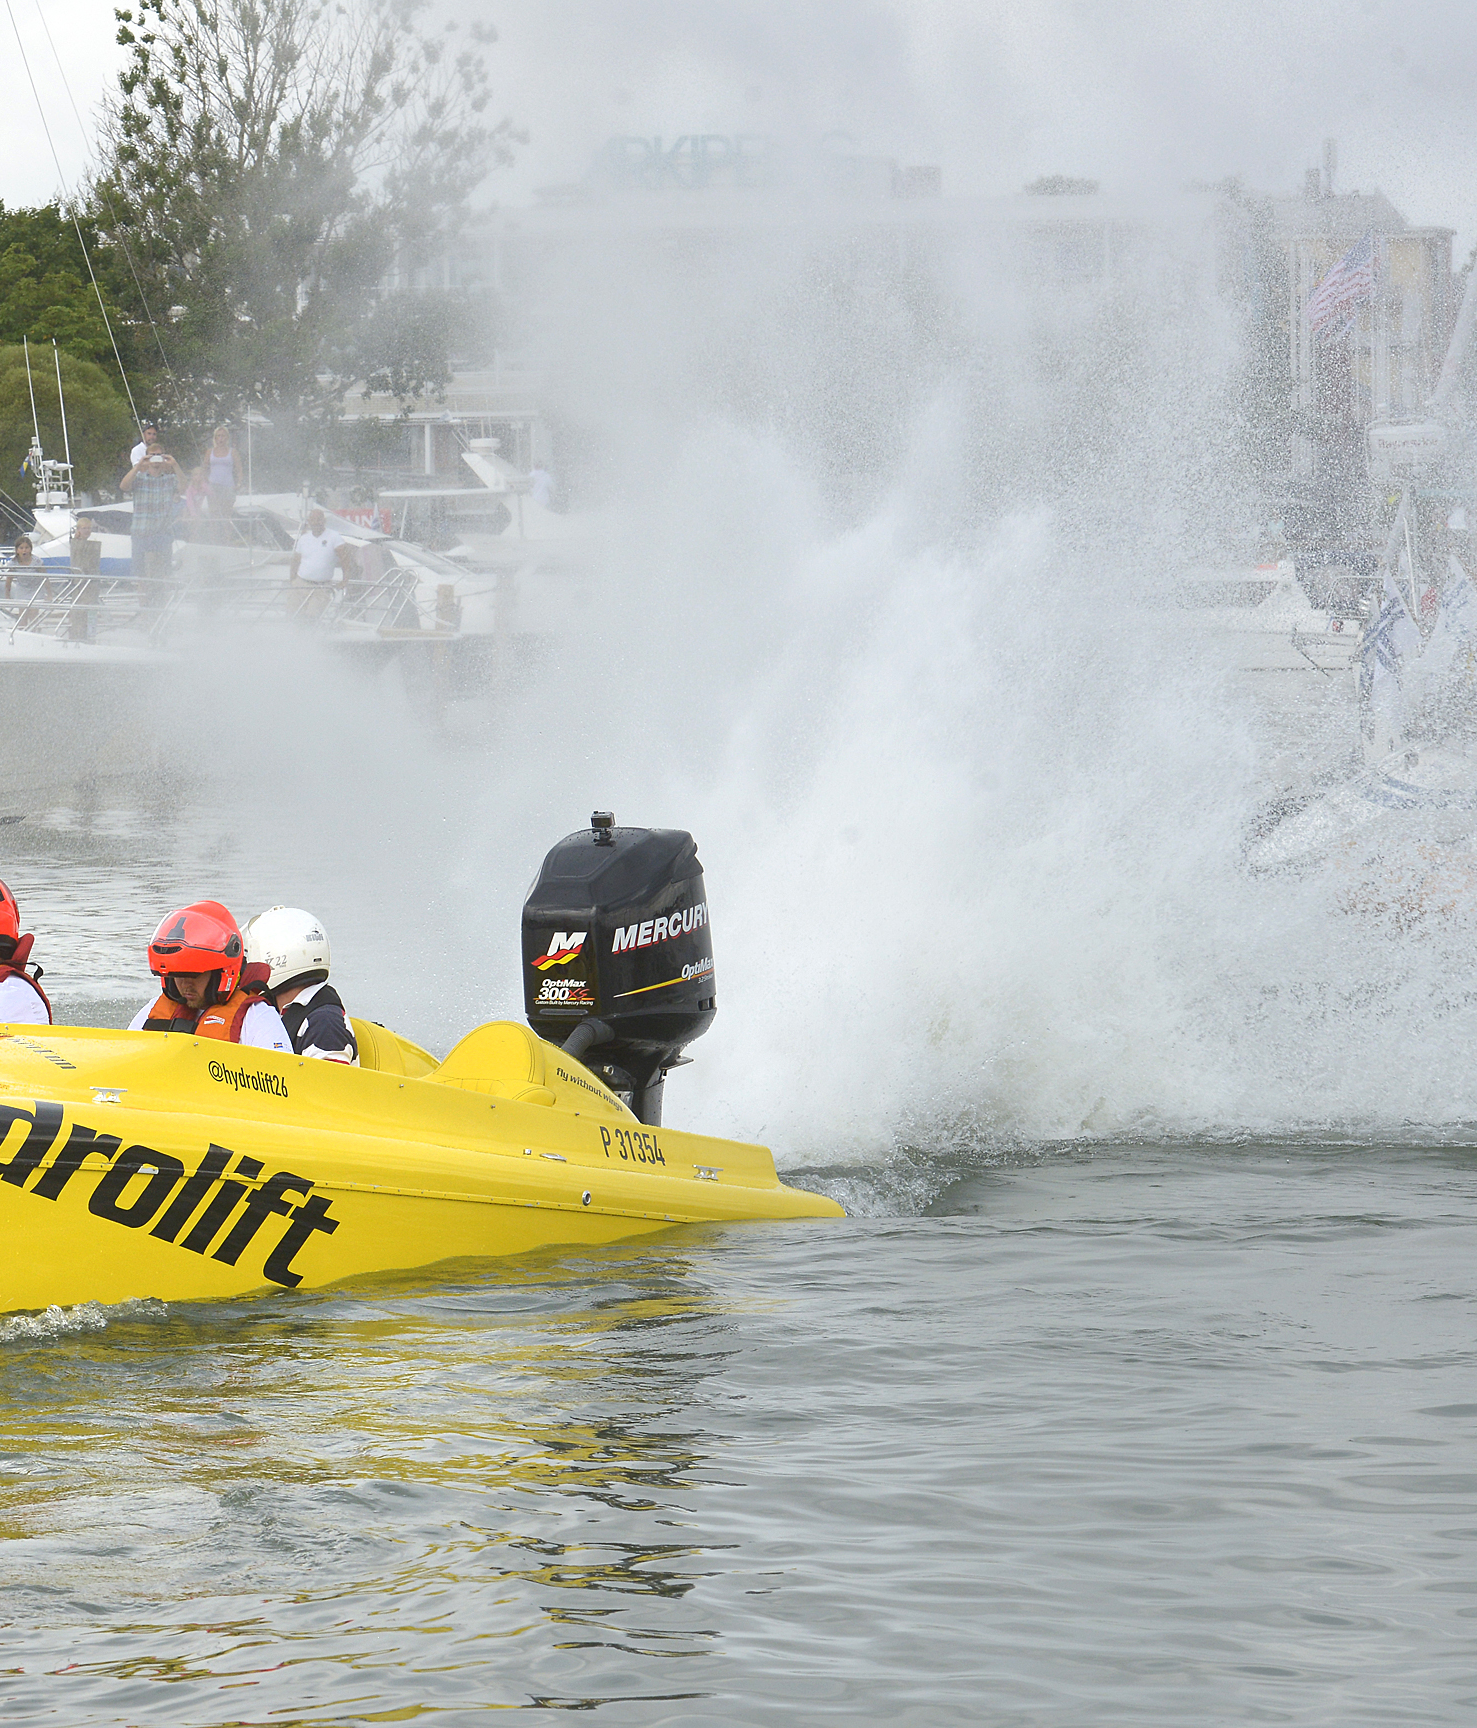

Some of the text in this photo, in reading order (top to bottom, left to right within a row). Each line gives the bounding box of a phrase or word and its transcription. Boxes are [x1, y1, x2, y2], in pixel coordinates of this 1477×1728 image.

[611, 902, 709, 955] MERCURY
[542, 979, 587, 989] OptiMax
[208, 1060, 289, 1098] @hydrolift26
[556, 1067, 623, 1112] fly without wings
[599, 1126, 666, 1166] P 31354
